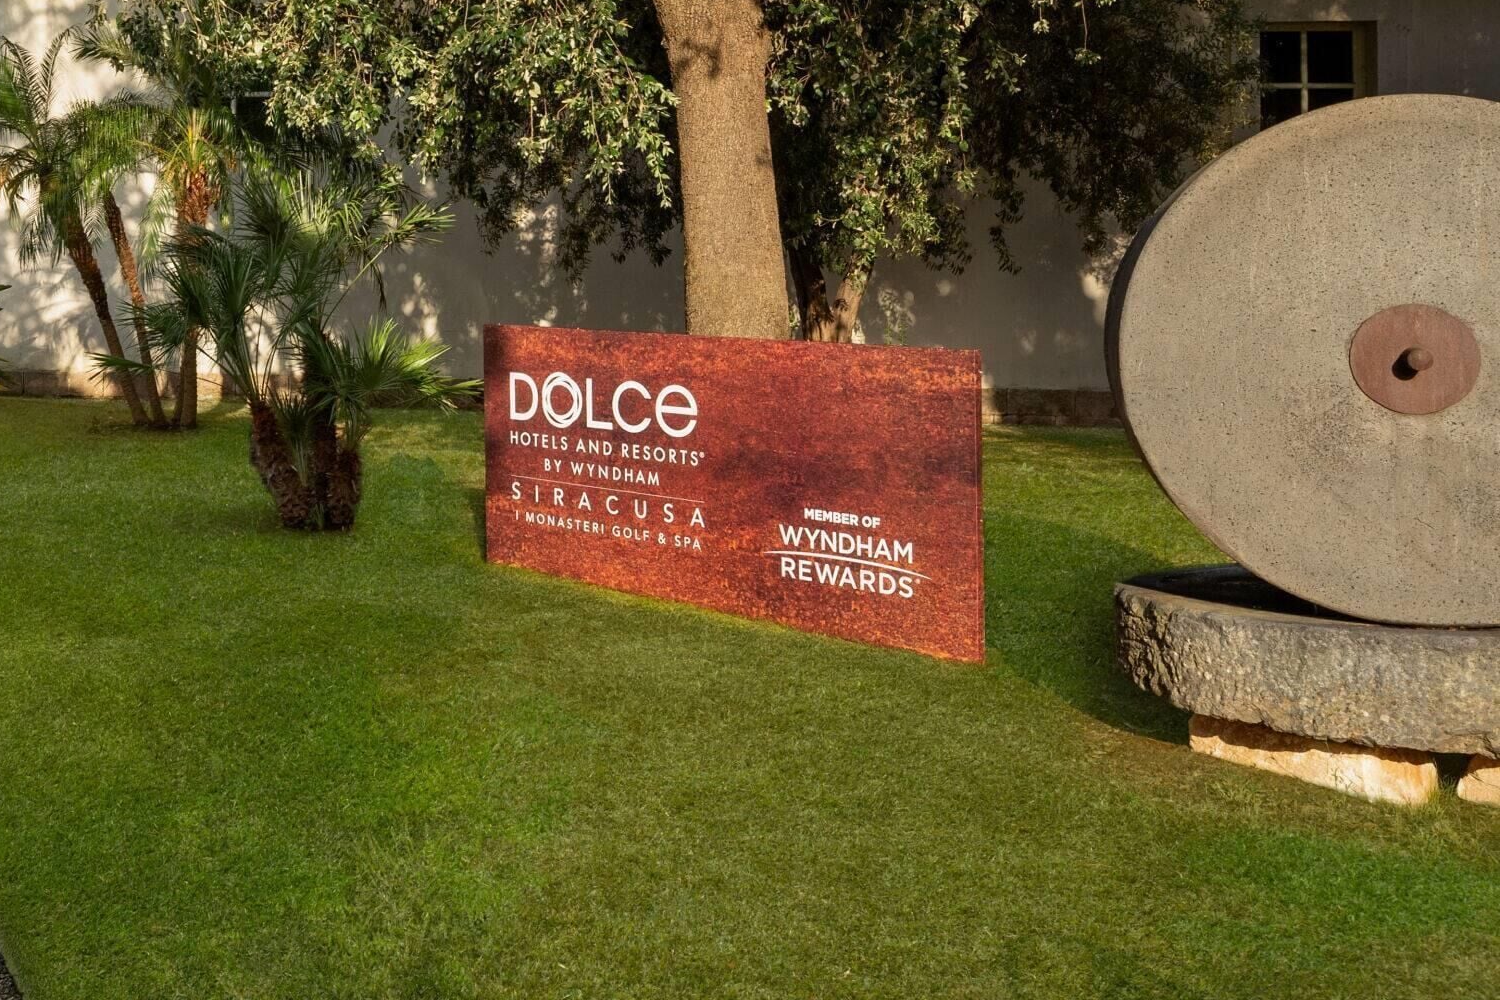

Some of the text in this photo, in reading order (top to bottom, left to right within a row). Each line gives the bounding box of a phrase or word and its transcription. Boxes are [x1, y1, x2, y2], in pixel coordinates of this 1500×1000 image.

[510, 430, 569, 451] HOTELS
[575, 438, 613, 456] AND
[544, 458, 660, 487] BY WYNDHAM
[511, 481, 706, 529] SIRACUSA
[804, 508, 881, 528] MEMBER OF
[525, 511, 605, 535] MONASTERI
[611, 525, 650, 542] GOLF
[657, 532, 667, 545] &
[674, 535, 702, 551] SPA
[779, 523, 914, 564] WYNDHAM
